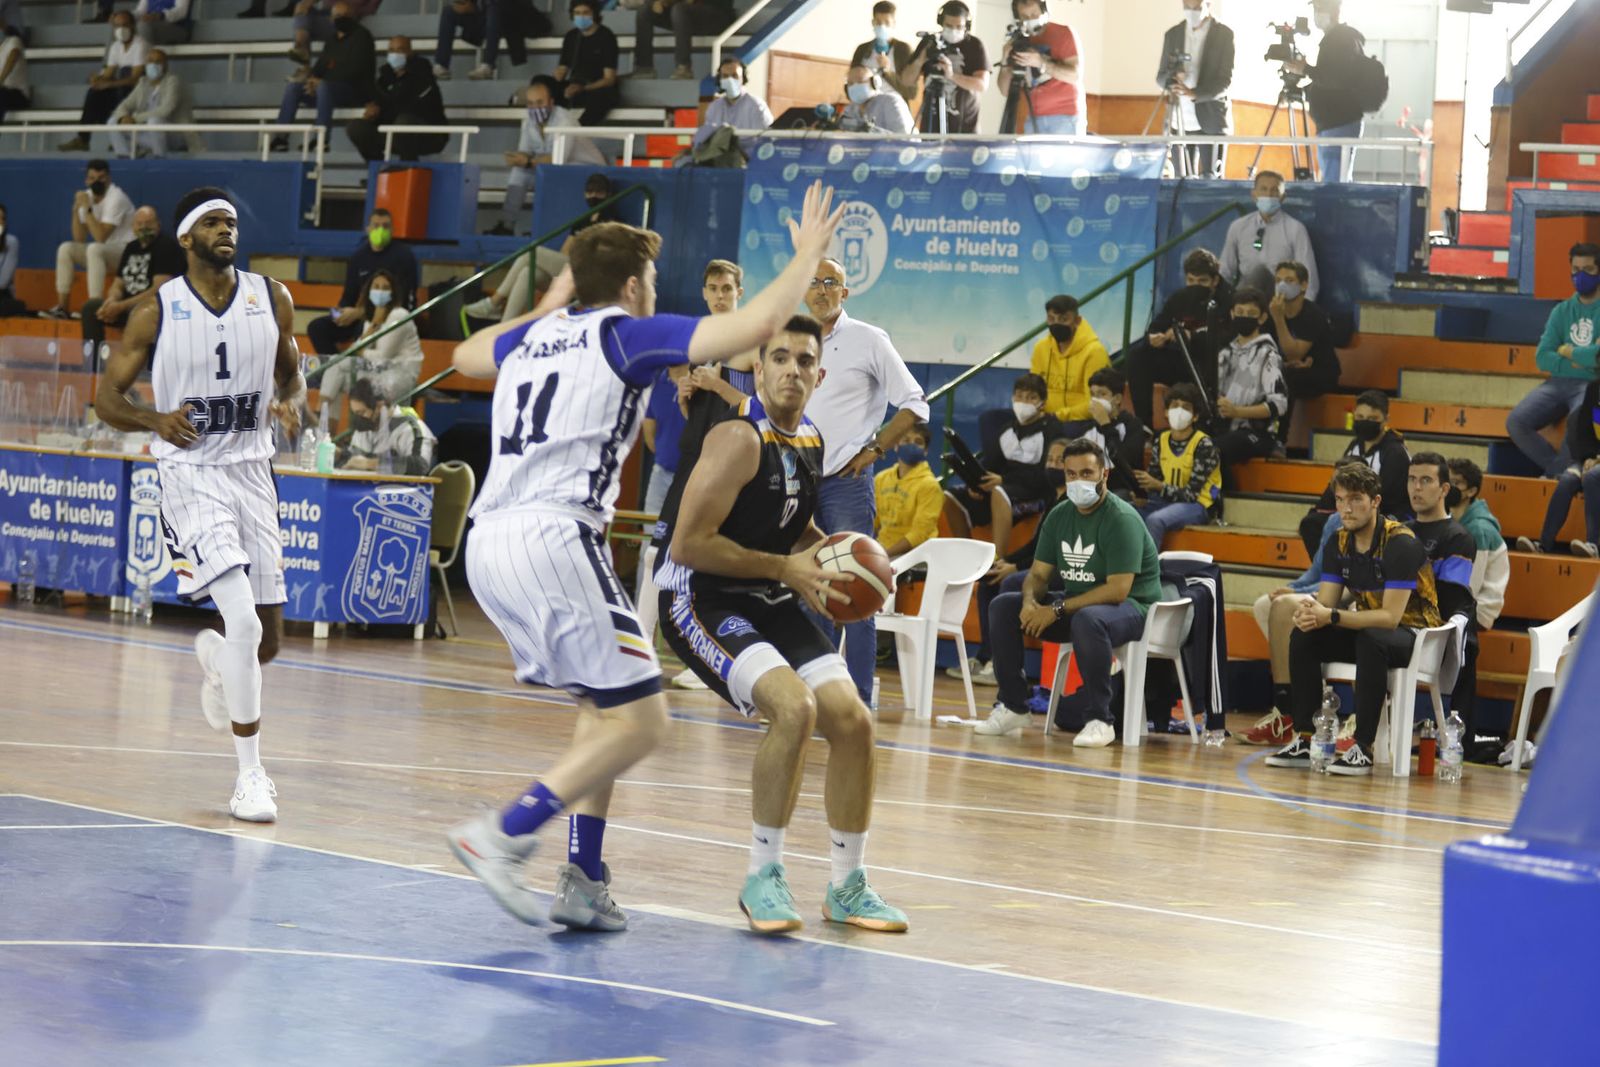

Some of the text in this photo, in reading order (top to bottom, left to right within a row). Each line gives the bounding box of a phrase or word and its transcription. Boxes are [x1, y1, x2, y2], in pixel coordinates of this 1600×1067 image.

[891, 213, 1020, 236] Ayuntamiento
[925, 236, 1018, 258] de Huelva
[954, 261, 968, 273] de
[970, 261, 1020, 275] Deportes
[215, 341, 231, 380] 1
[183, 391, 262, 436] CDH
[499, 371, 559, 456] 11
[0, 468, 117, 501] Ayuntamiento
[29, 497, 115, 528] de Huelva
[70, 530, 116, 548] Deportes
[280, 524, 319, 550] elva
[283, 556, 320, 572] portes
[1060, 568, 1096, 582] adidas
